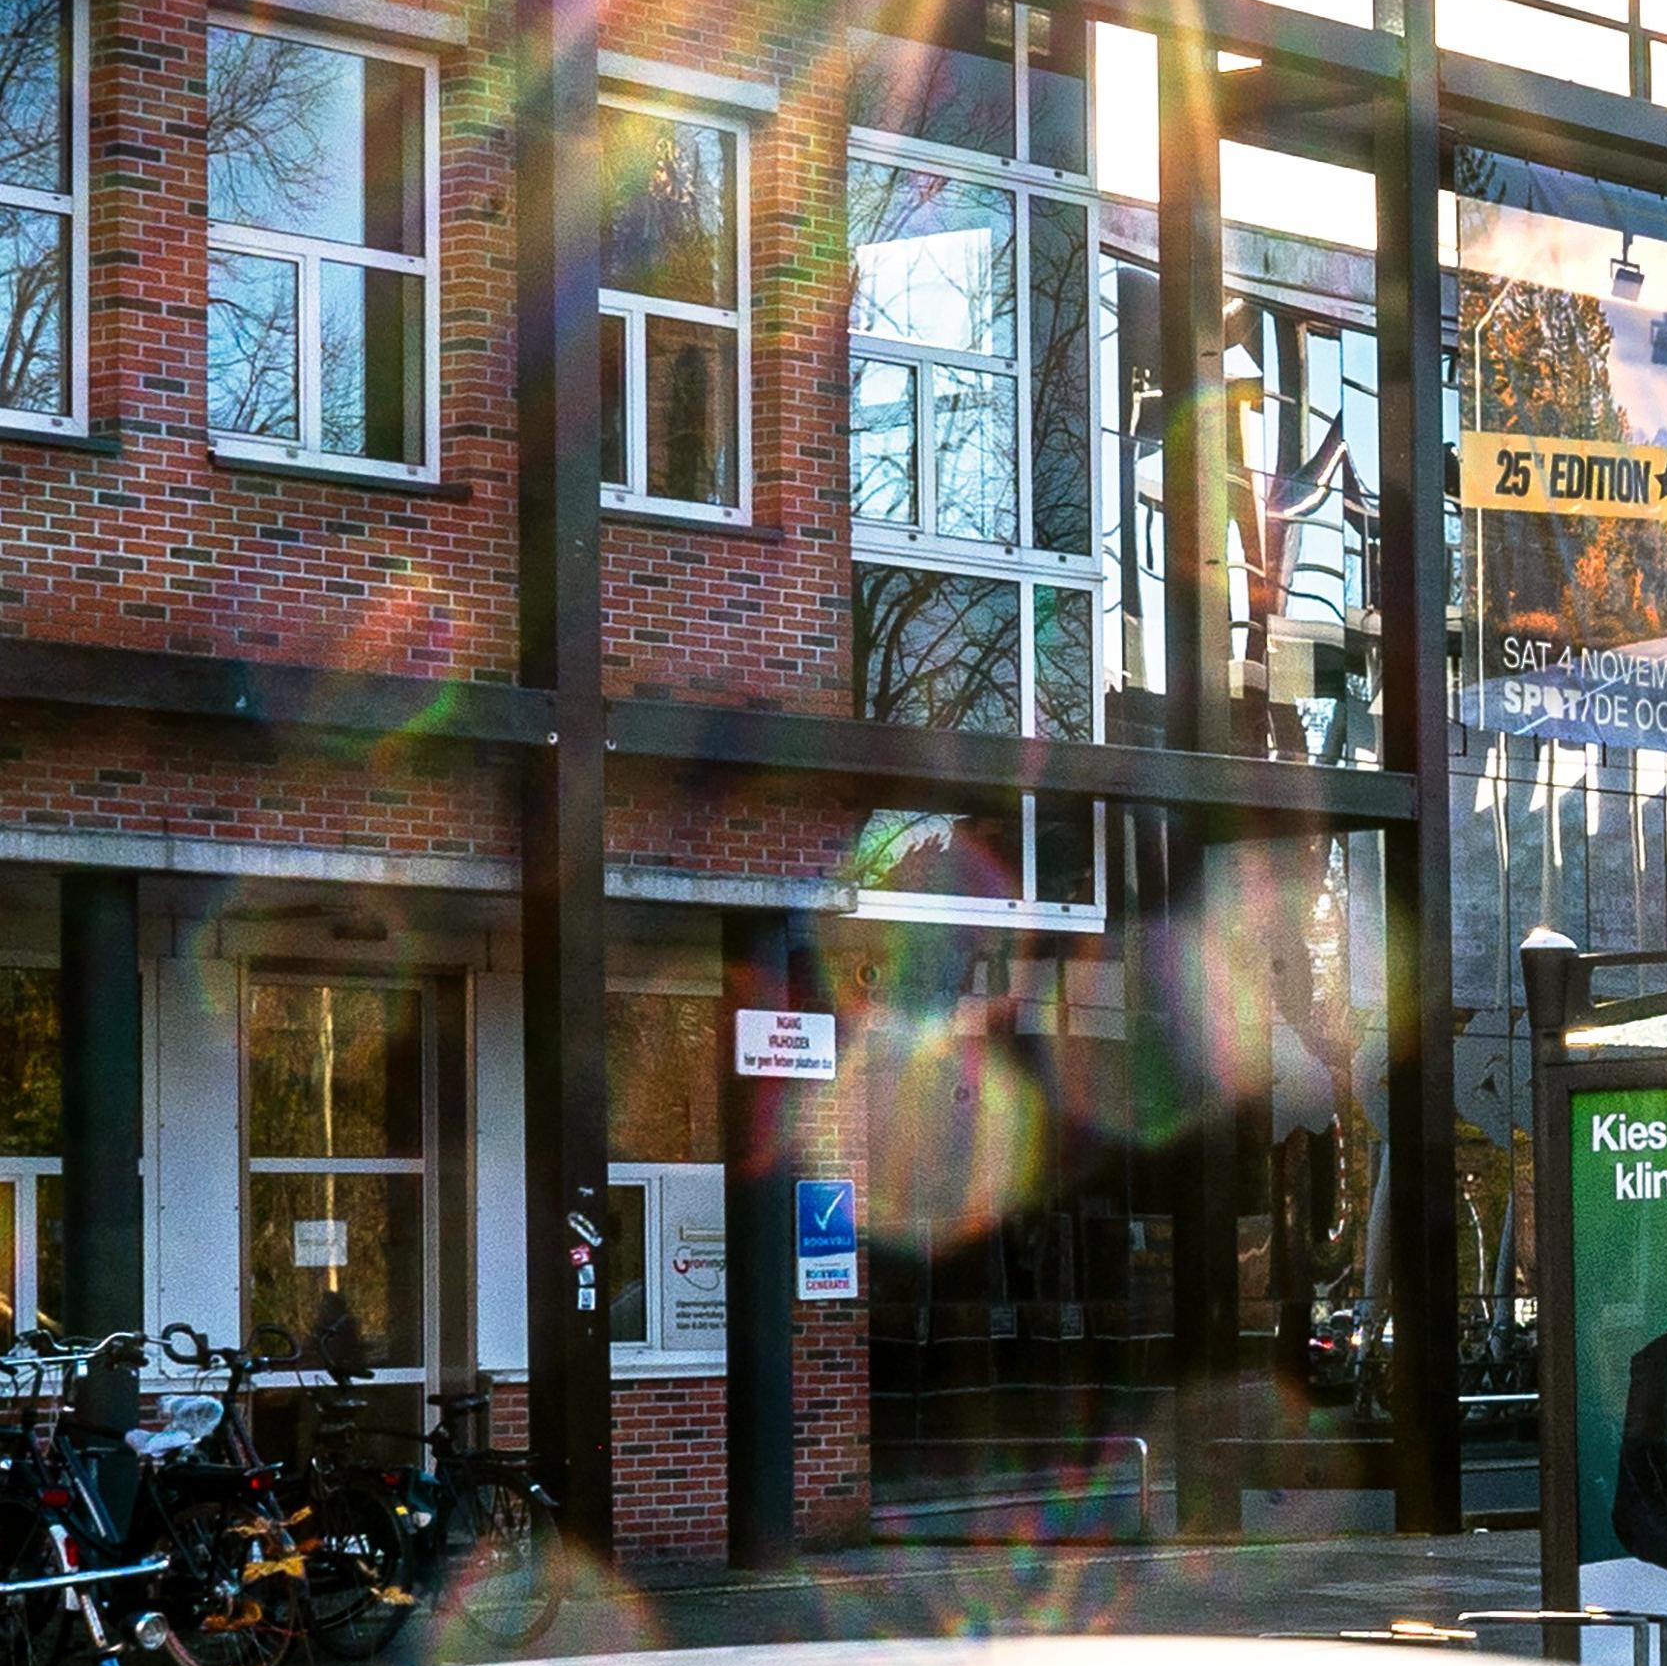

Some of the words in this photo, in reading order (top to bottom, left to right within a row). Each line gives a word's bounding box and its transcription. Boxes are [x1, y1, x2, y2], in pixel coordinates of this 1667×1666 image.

[1550, 453, 1651, 504] EDITION
[1502, 637, 1551, 673] SAT
[1557, 646, 1574, 676] 4
[1592, 1113, 1667, 1152] Kies
